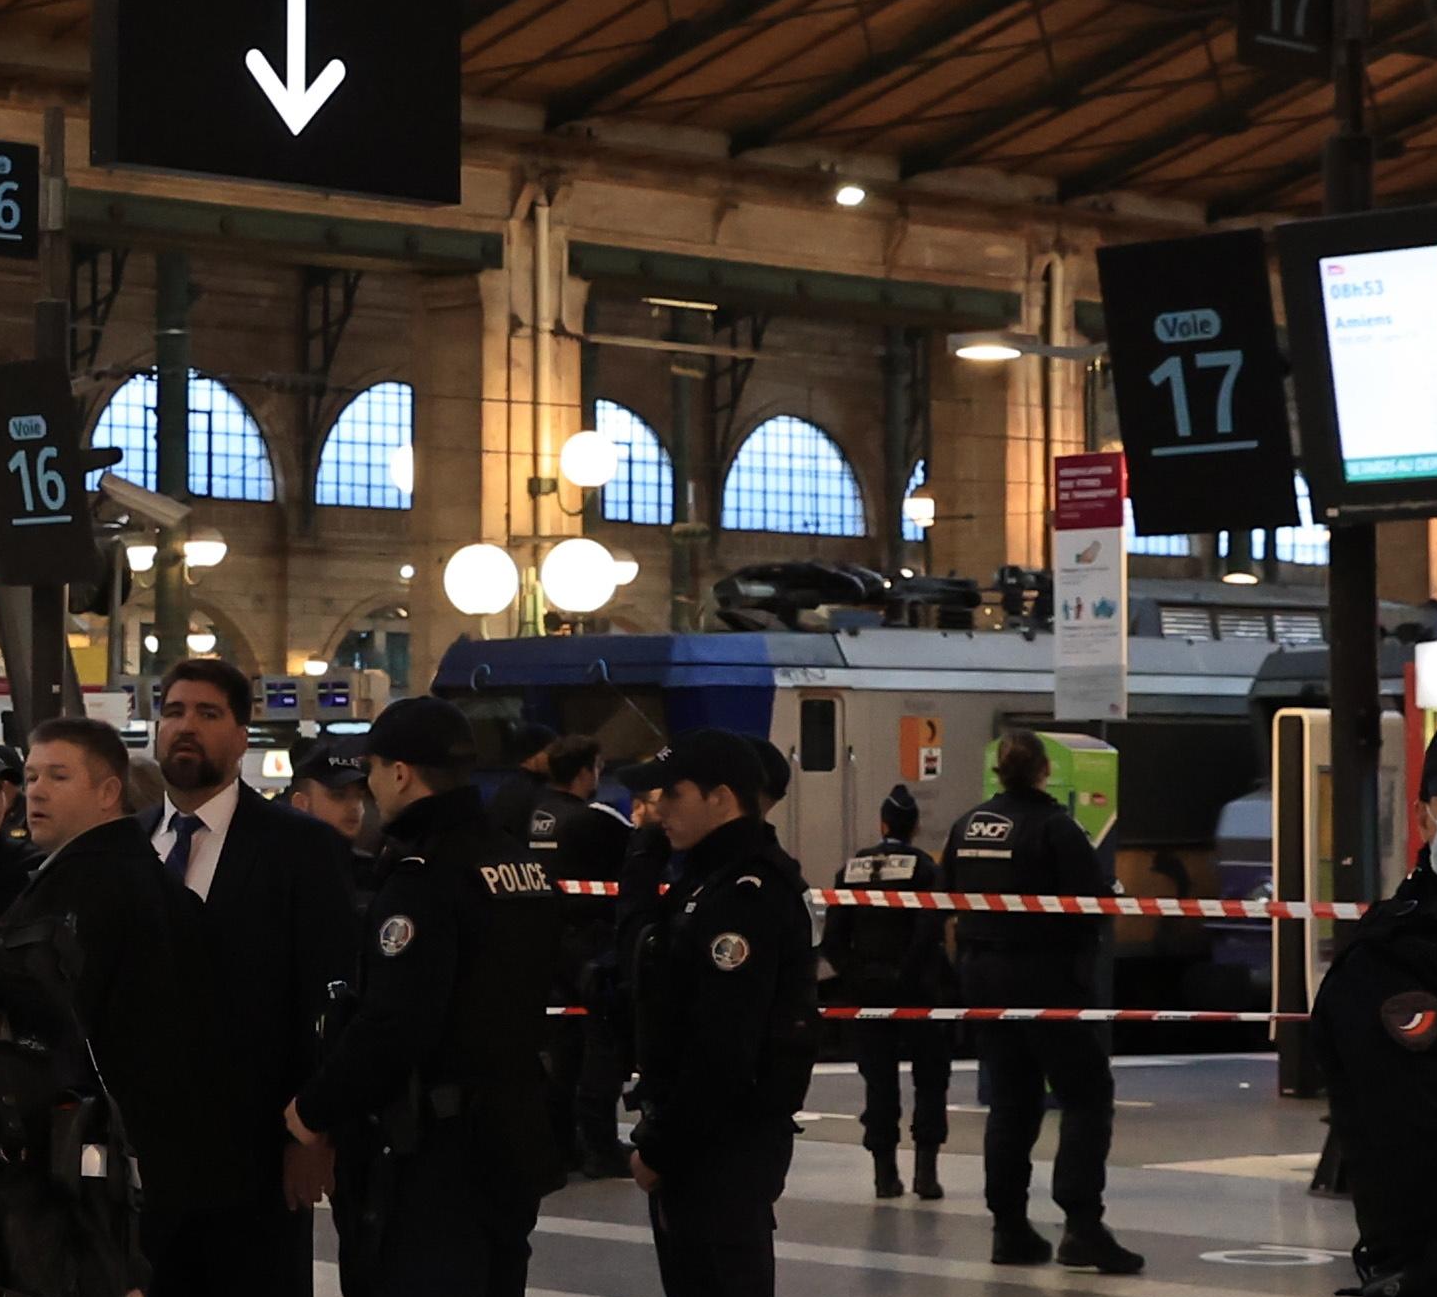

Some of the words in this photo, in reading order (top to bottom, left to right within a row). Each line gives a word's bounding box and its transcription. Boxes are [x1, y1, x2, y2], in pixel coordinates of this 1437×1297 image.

[1331, 280, 1384, 299] 08h53
[1162, 314, 1212, 338] Voie
[1335, 315, 1393, 329] Amiens
[1148, 349, 1244, 437] 17
[12, 419, 41, 437] Voie
[8, 446, 66, 512] 16
[967, 822, 1010, 837] SNCF
[480, 862, 552, 894] POLICE
